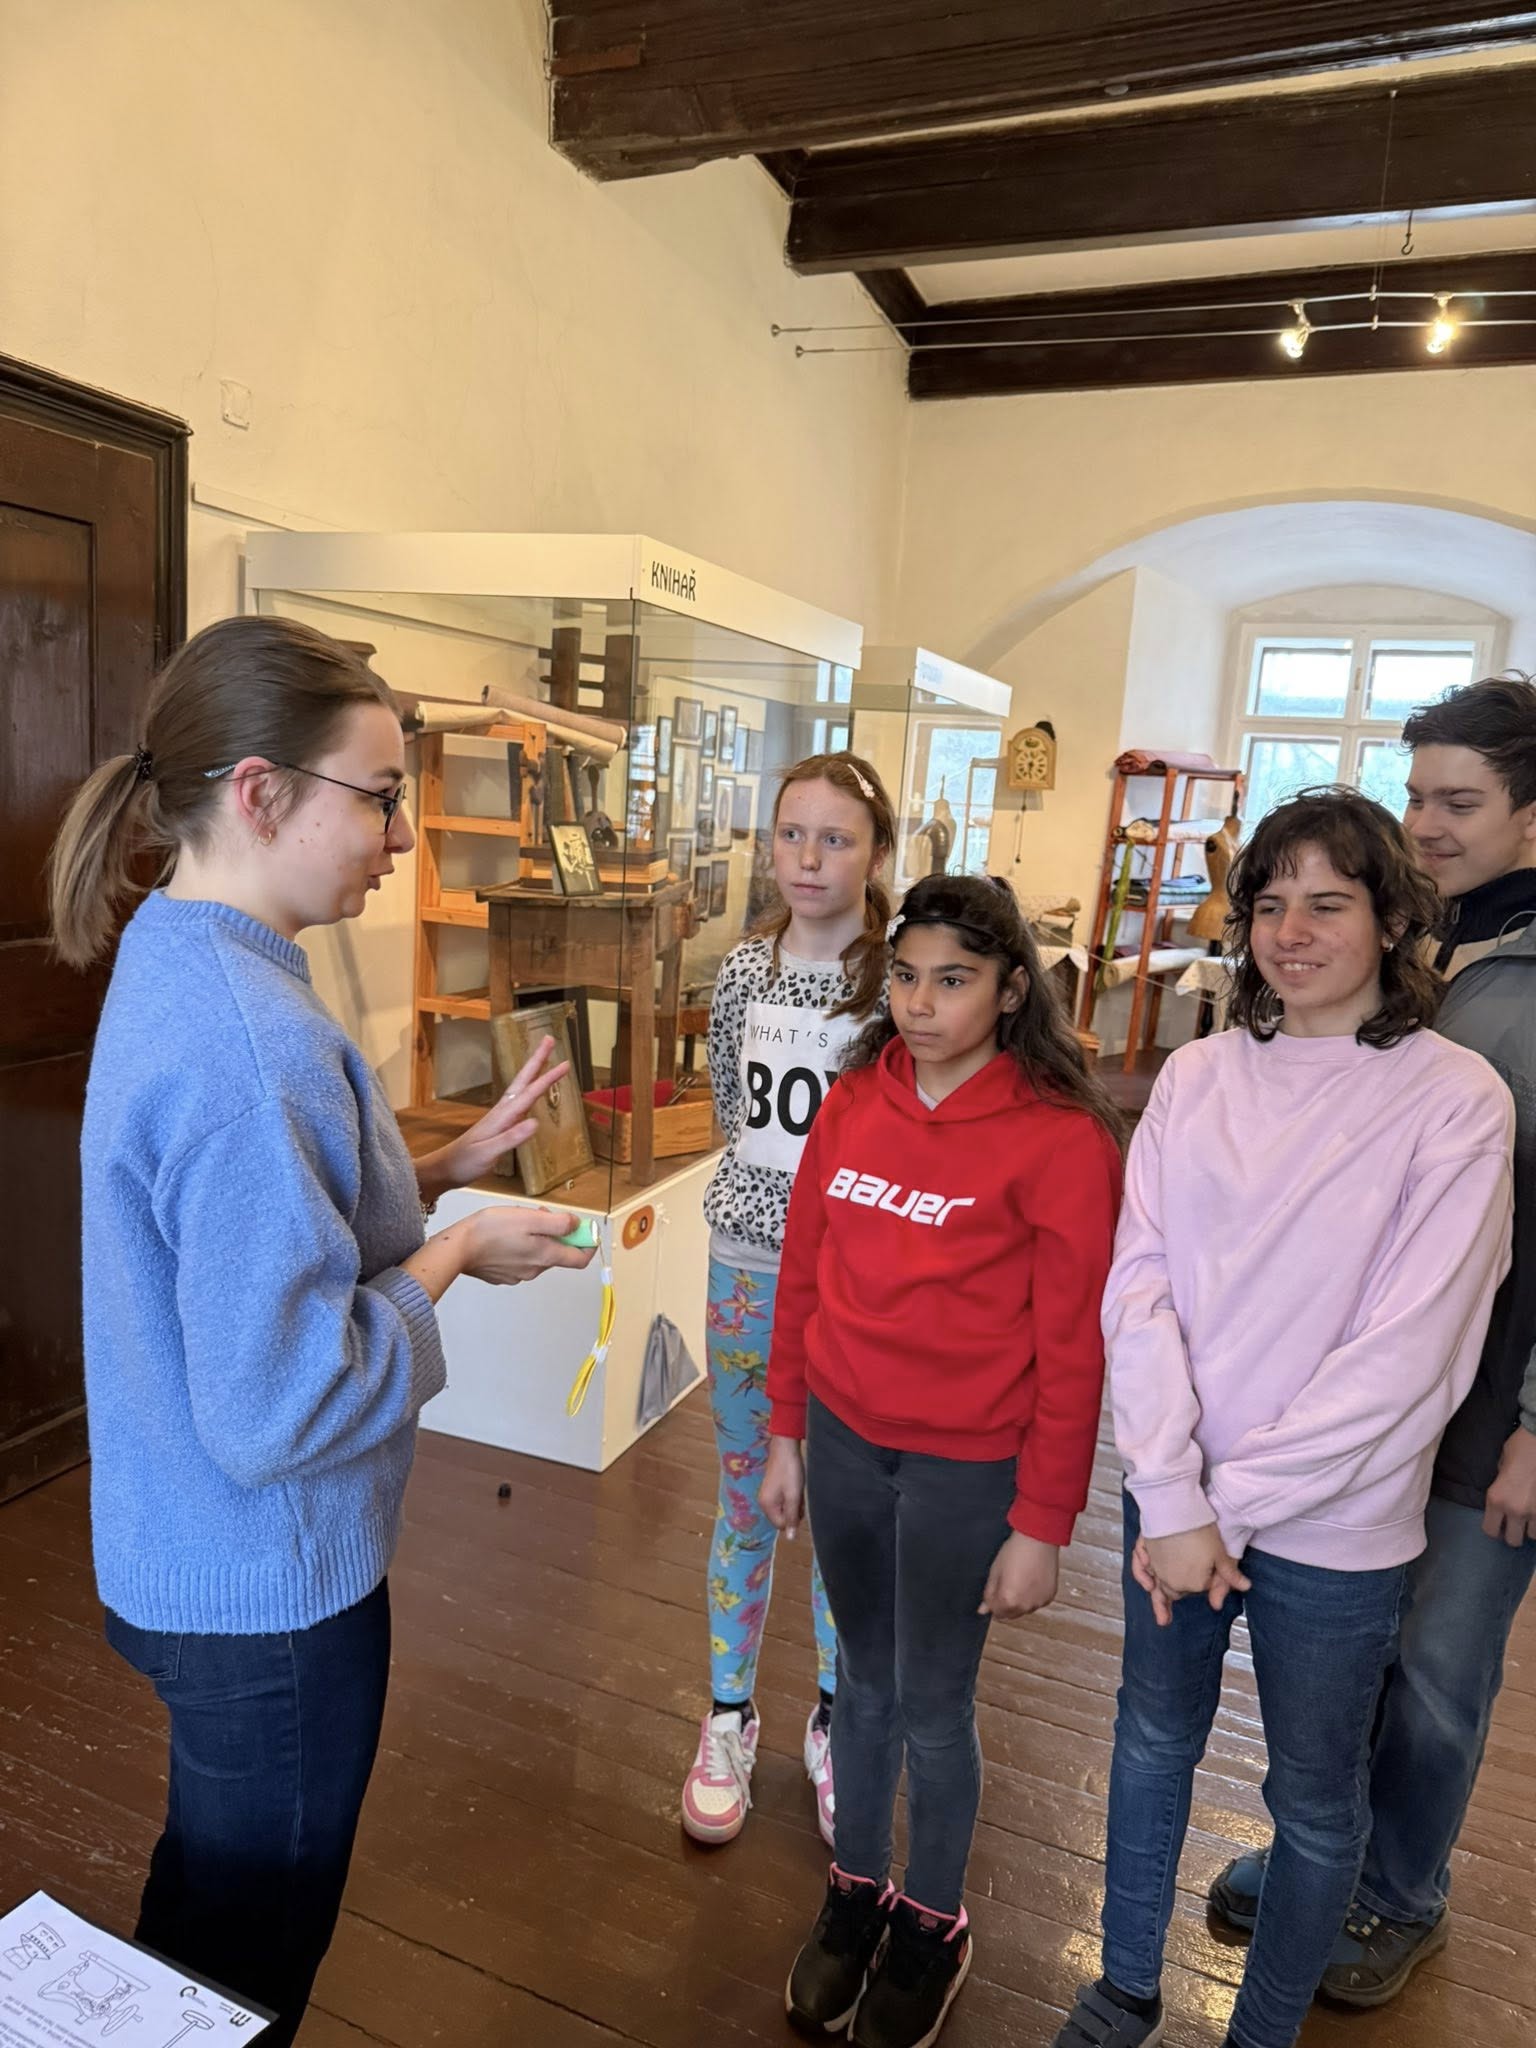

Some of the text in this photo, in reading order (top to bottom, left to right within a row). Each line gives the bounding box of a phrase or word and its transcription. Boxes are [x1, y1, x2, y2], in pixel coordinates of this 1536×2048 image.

[651, 560, 696, 602] KNIHAŘ
[751, 1025, 829, 1048] WHAT'S
[746, 1061, 838, 1136] BO
